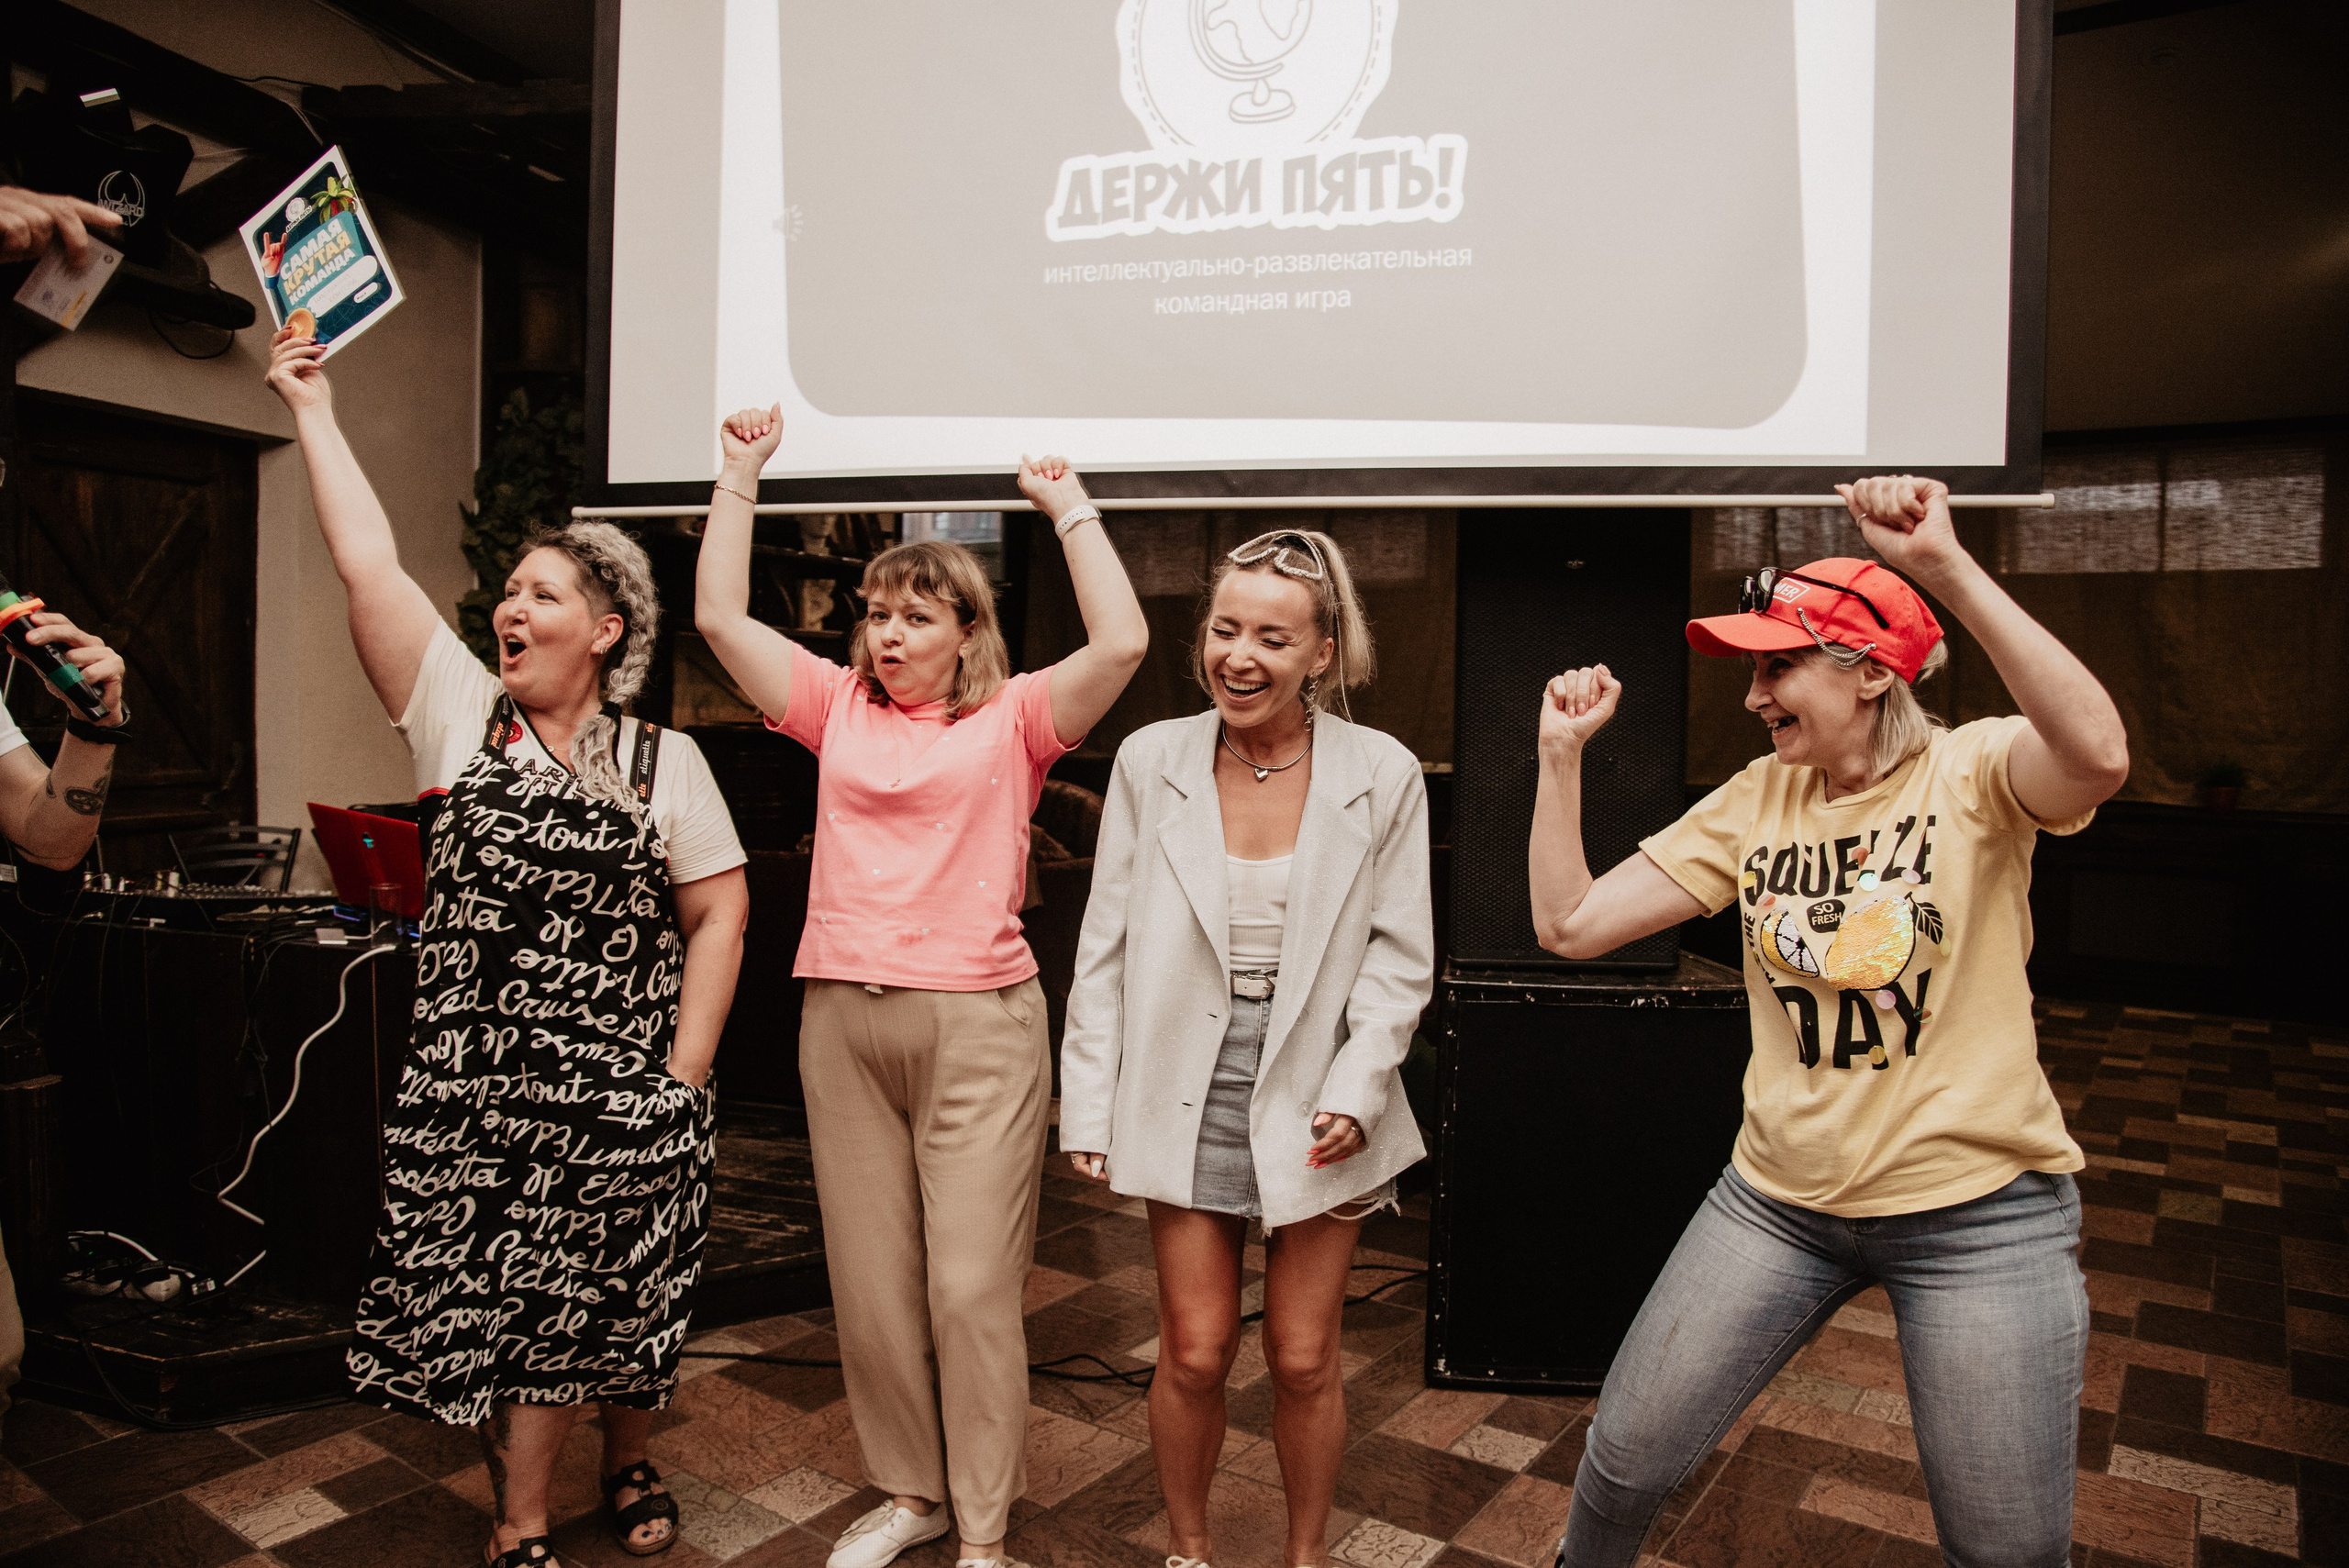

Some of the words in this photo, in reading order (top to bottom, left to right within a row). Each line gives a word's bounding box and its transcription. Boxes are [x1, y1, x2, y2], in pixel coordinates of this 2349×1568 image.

[1057, 156, 1264, 229] ДЕРЖИ
[1283, 147, 1455, 217] ПЯТЬ!
[280, 218, 343, 280] САМАЯ
[283, 230, 351, 295] КРУТАЯ
[289, 248, 355, 306] КОМАНДА
[1044, 248, 1473, 284] интеллектуально-развлекательная
[1154, 292, 1287, 316] командная
[1295, 288, 1352, 314] игра
[1811, 911, 1842, 926] FRESH
[1813, 902, 1835, 915] SO
[1773, 967, 1932, 1071] DAY
